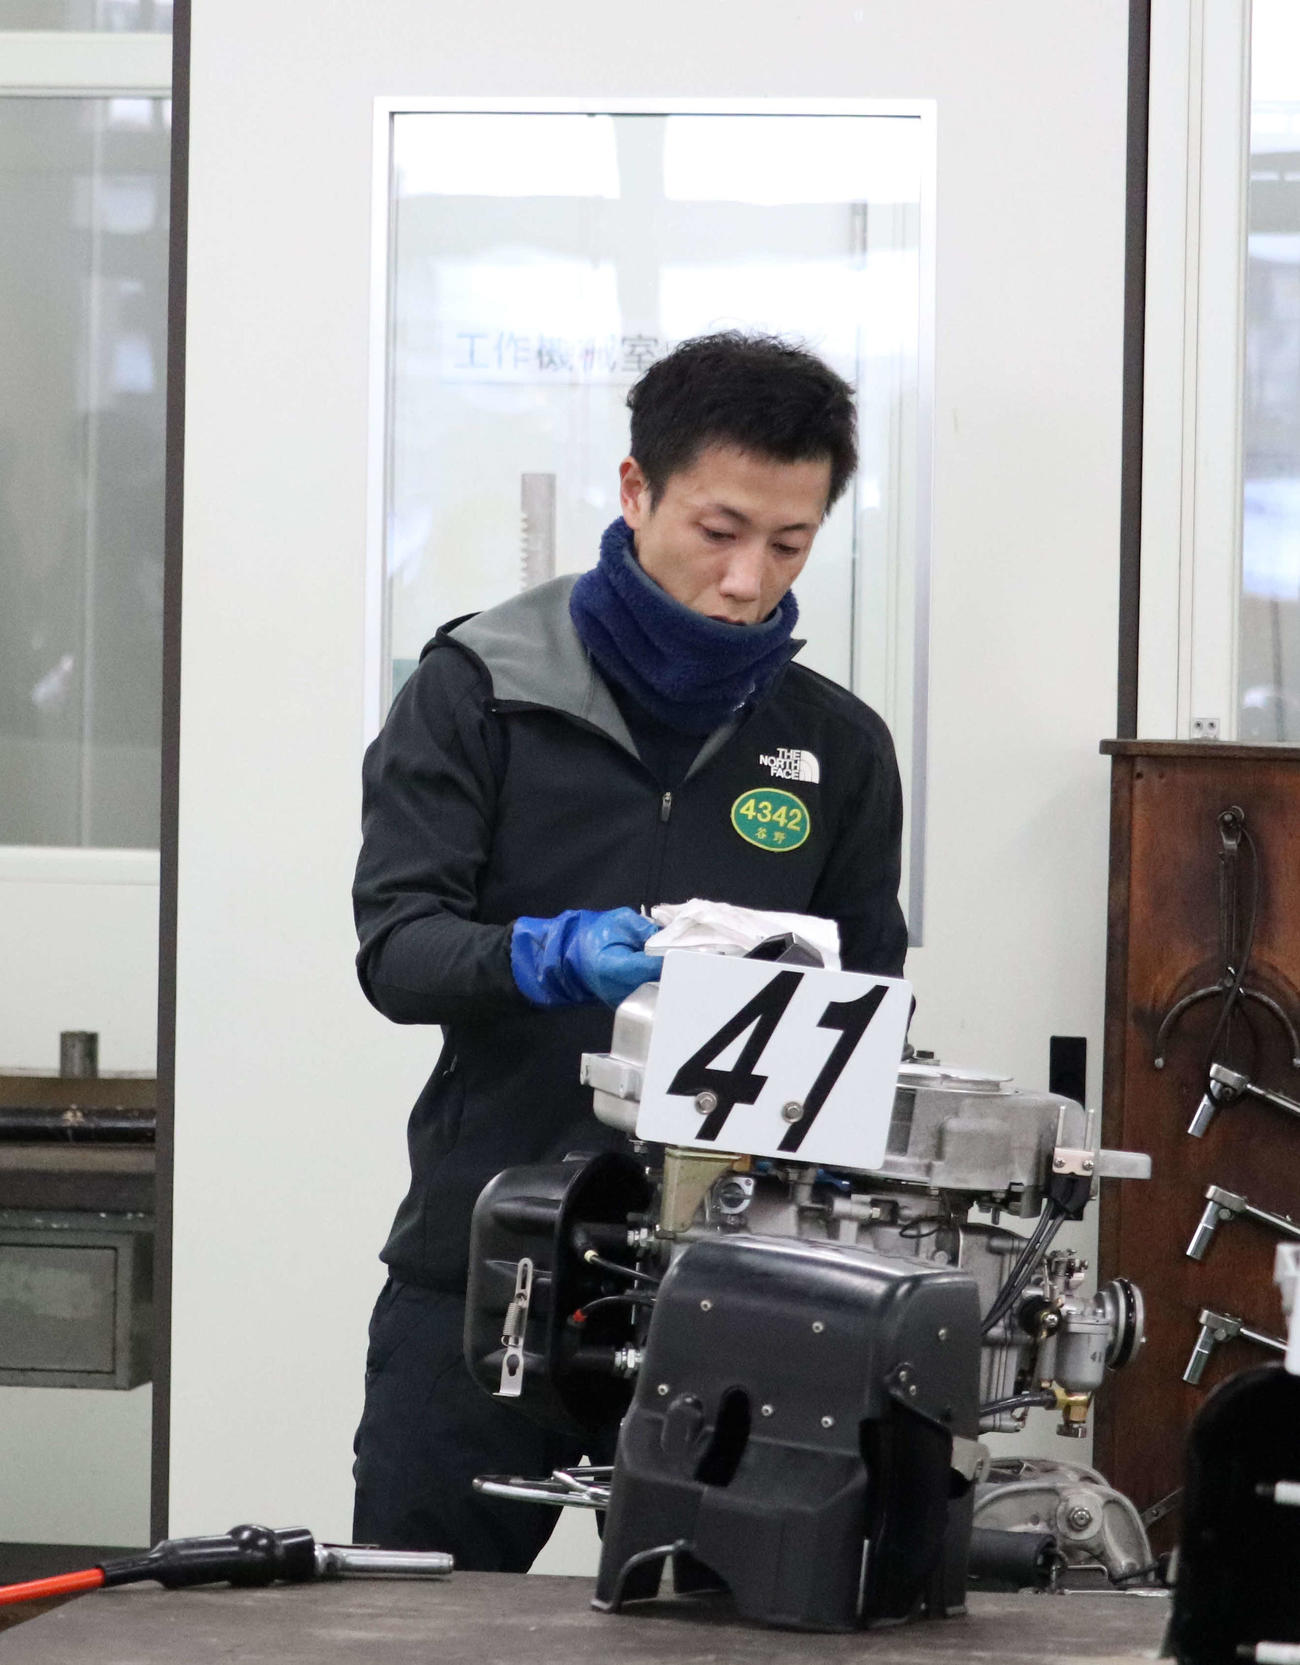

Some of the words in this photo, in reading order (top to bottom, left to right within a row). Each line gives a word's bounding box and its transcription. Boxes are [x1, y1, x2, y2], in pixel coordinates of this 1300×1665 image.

[777, 748, 801, 760] THE
[760, 755, 800, 770] NORTH
[770, 767, 800, 780] FACE
[740, 799, 802, 831] 4342
[666, 970, 889, 1152] 41
